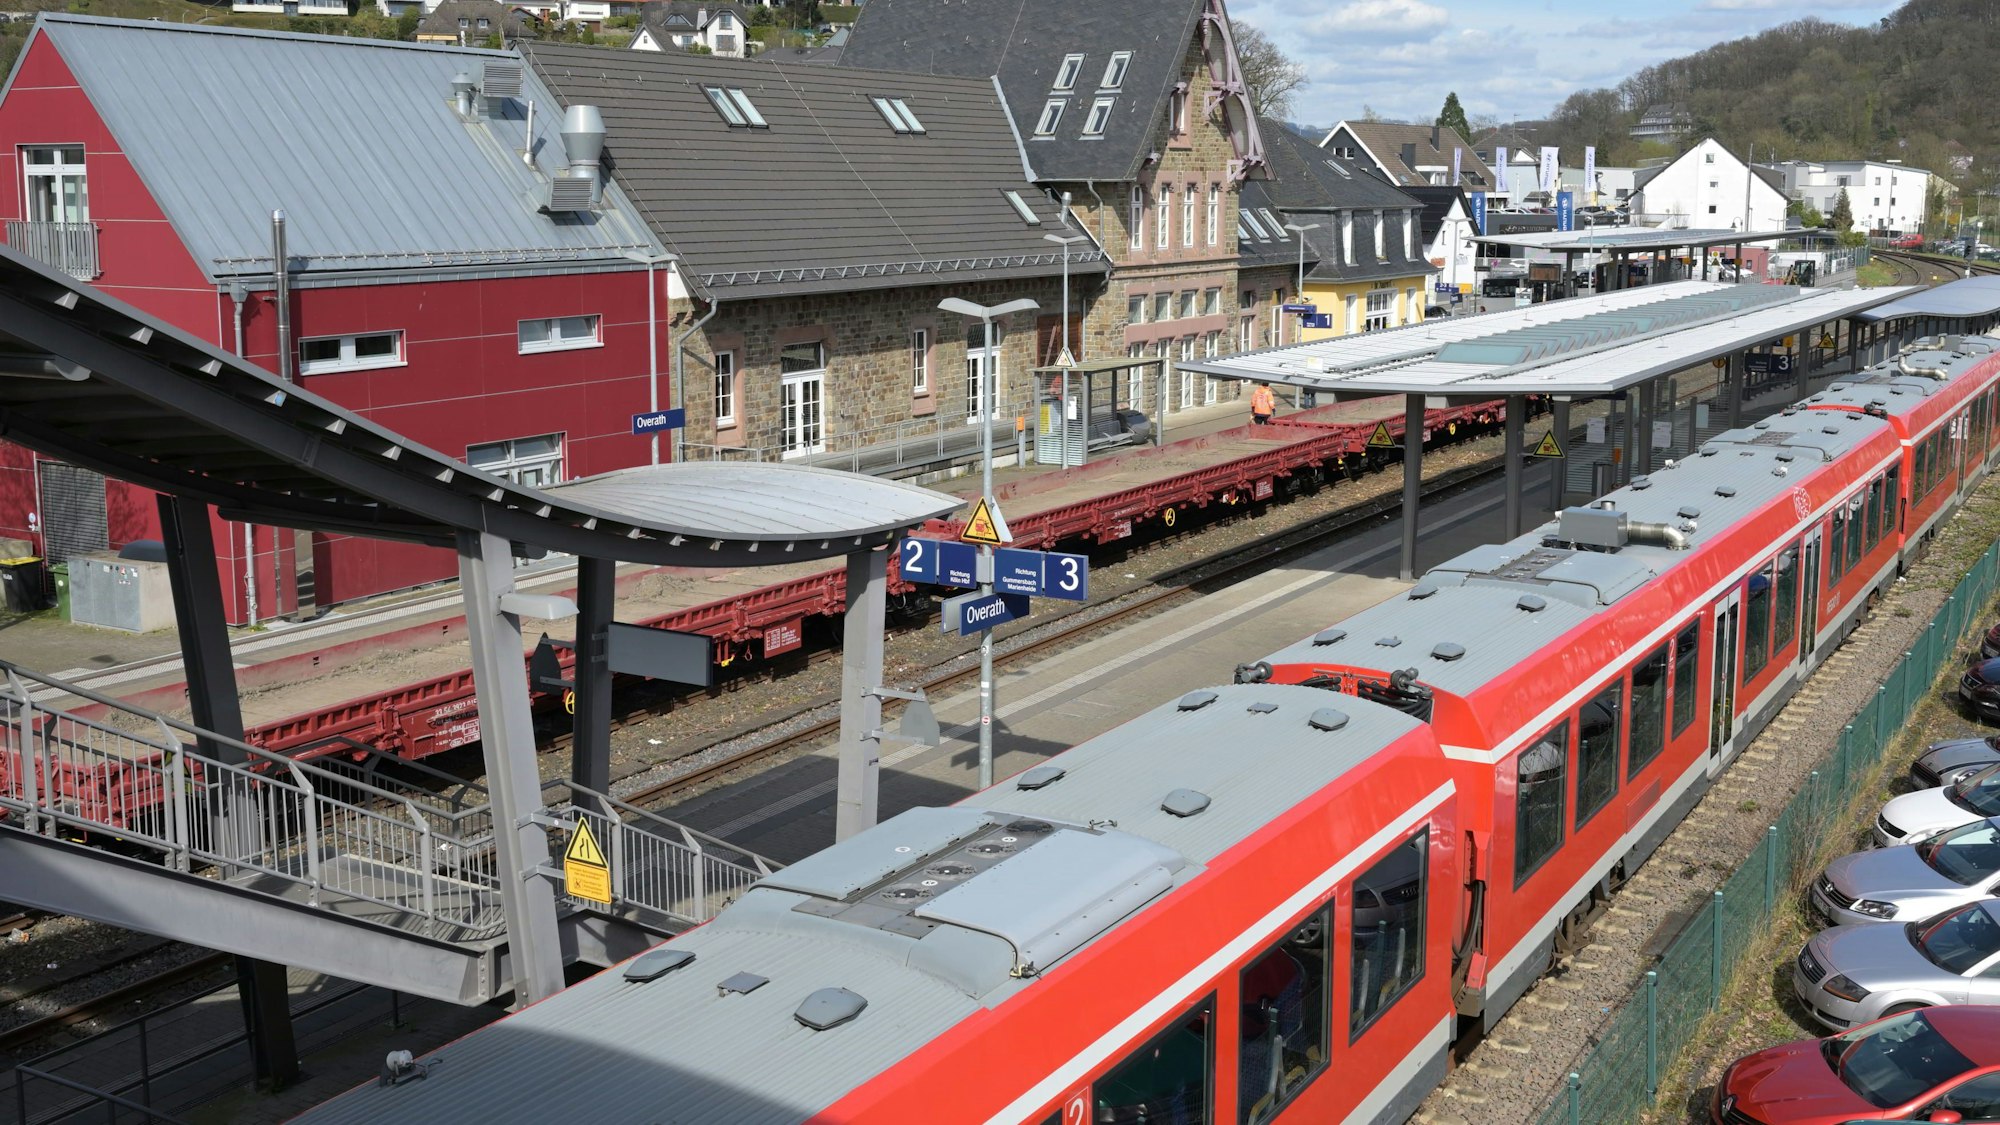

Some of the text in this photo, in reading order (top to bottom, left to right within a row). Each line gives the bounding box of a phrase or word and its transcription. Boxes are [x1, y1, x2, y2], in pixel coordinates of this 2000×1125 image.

[1324, 314, 1331, 326] 1
[1779, 355, 1789, 370] 3
[636, 414, 667, 428] Overath
[905, 540, 923, 573] 2
[950, 569, 971, 579] Richtung
[1015, 567, 1037, 577] Richtung
[1059, 557, 1079, 591] 3
[1002, 576, 1037, 586] Gummersbach
[1007, 583, 1037, 593] Marienheide
[966, 597, 1005, 624] Overath
[1069, 1098, 1084, 1125] 2
